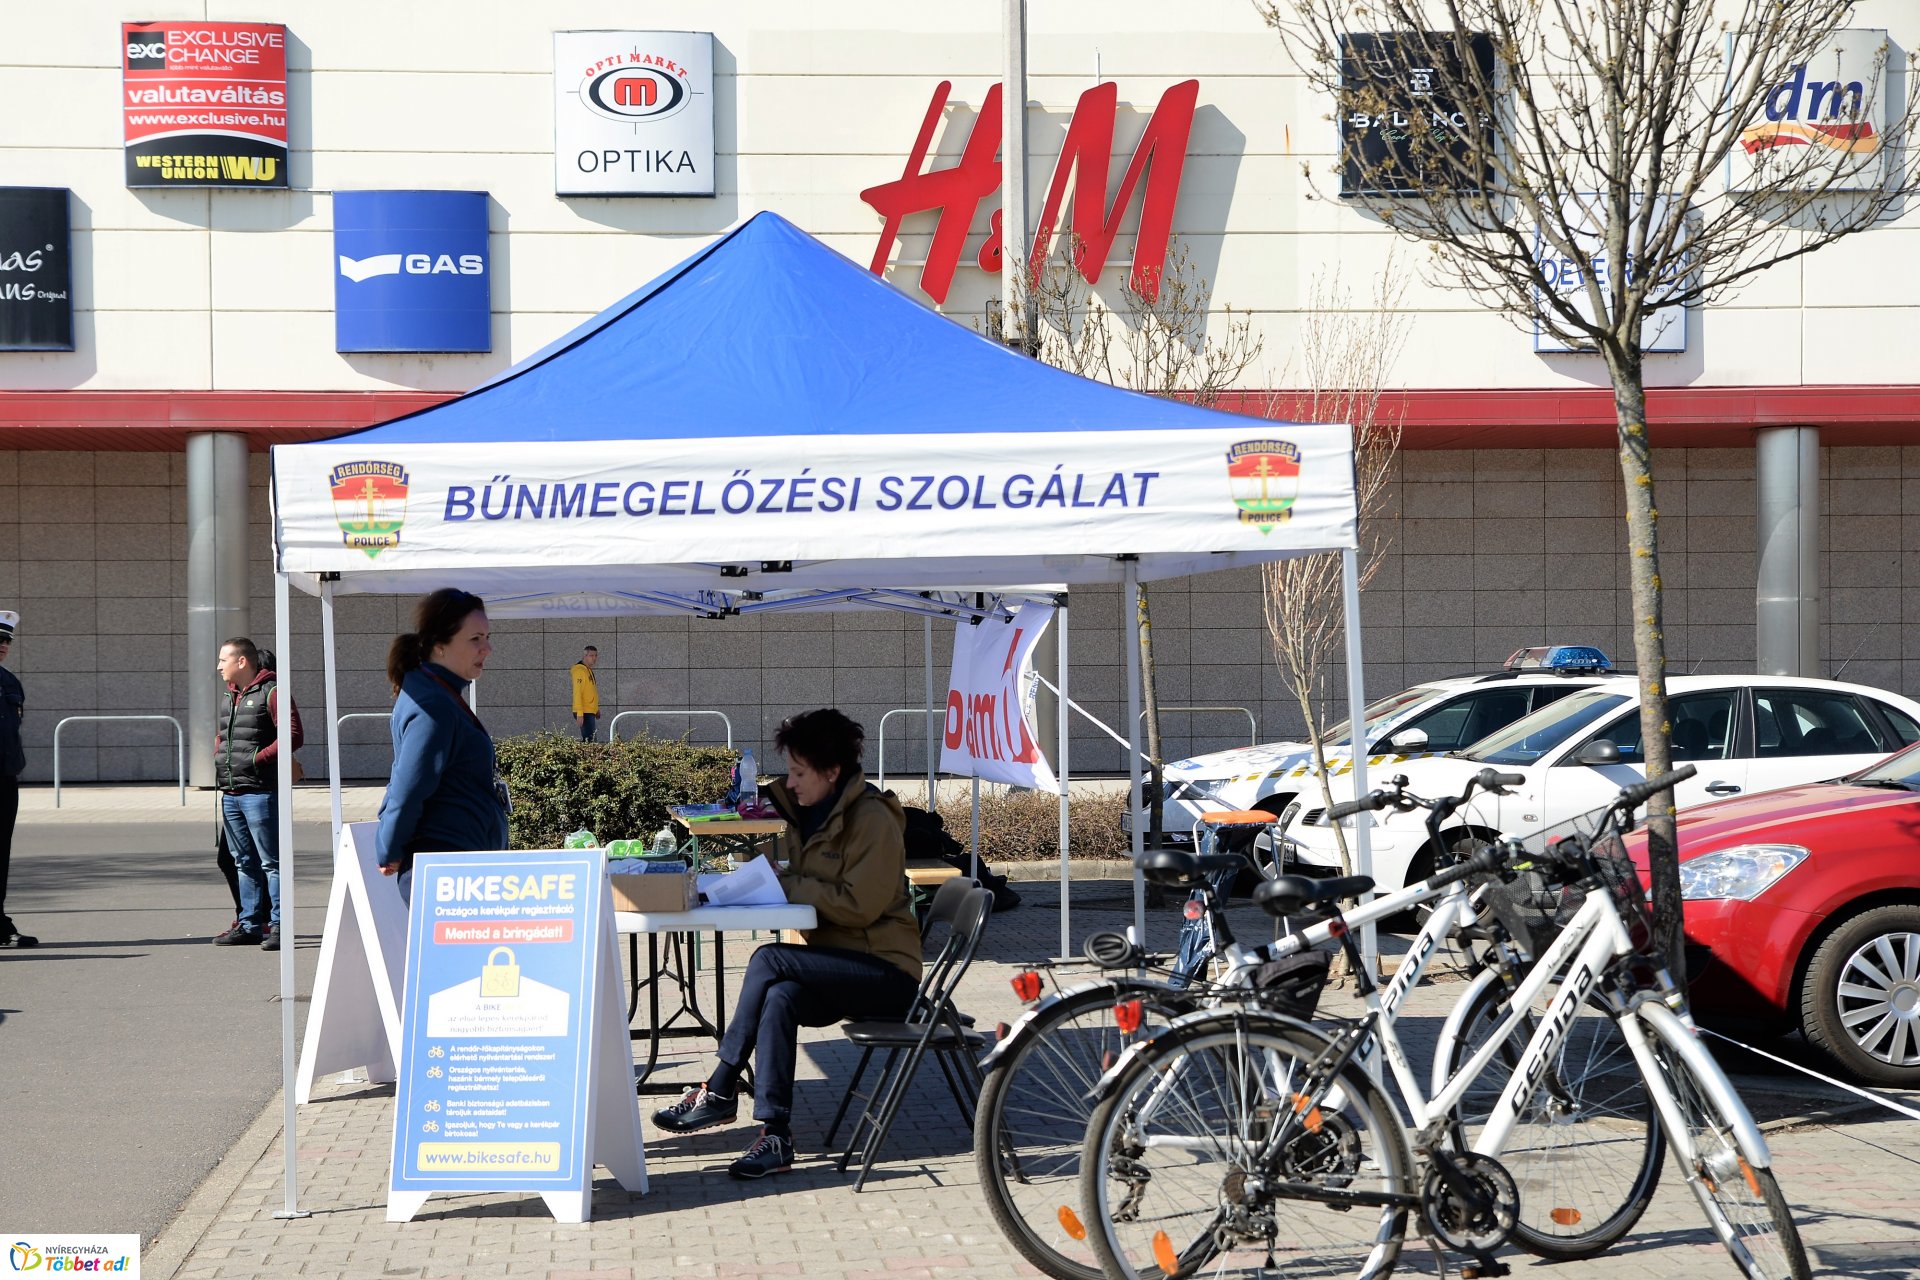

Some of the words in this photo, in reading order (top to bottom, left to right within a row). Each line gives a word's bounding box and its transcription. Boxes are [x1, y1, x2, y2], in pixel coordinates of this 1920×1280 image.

[168, 31, 283, 48] EXCLUSIVE
[127, 43, 166, 58] exc
[168, 48, 259, 64] CHANGE
[585, 55, 622, 77] OPTI
[630, 53, 688, 78] MARKT
[128, 85, 284, 105] valutaváltás
[1765, 64, 1863, 122] dm
[128, 112, 285, 126] www.exclusive.hu
[136, 155, 218, 167] WESTERN
[577, 149, 696, 173] OPTIKA
[162, 167, 218, 179] UNION
[405, 254, 484, 275] GAS
[337, 460, 400, 478] RENDŐRSÉG
[443, 467, 862, 522] BŰNMEGELŐZÉSI
[876, 463, 1160, 511] SZOLGÁLAT
[1248, 512, 1281, 522] POLICE
[354, 536, 390, 546] POLICE
[436, 874, 576, 902] BIKESAFE
[445, 927, 490, 940] Mentsd
[493, 931, 500, 939] a
[1511, 963, 1592, 1117] GEPIDA
[426, 1151, 551, 1164] www.bikesafe.hu
